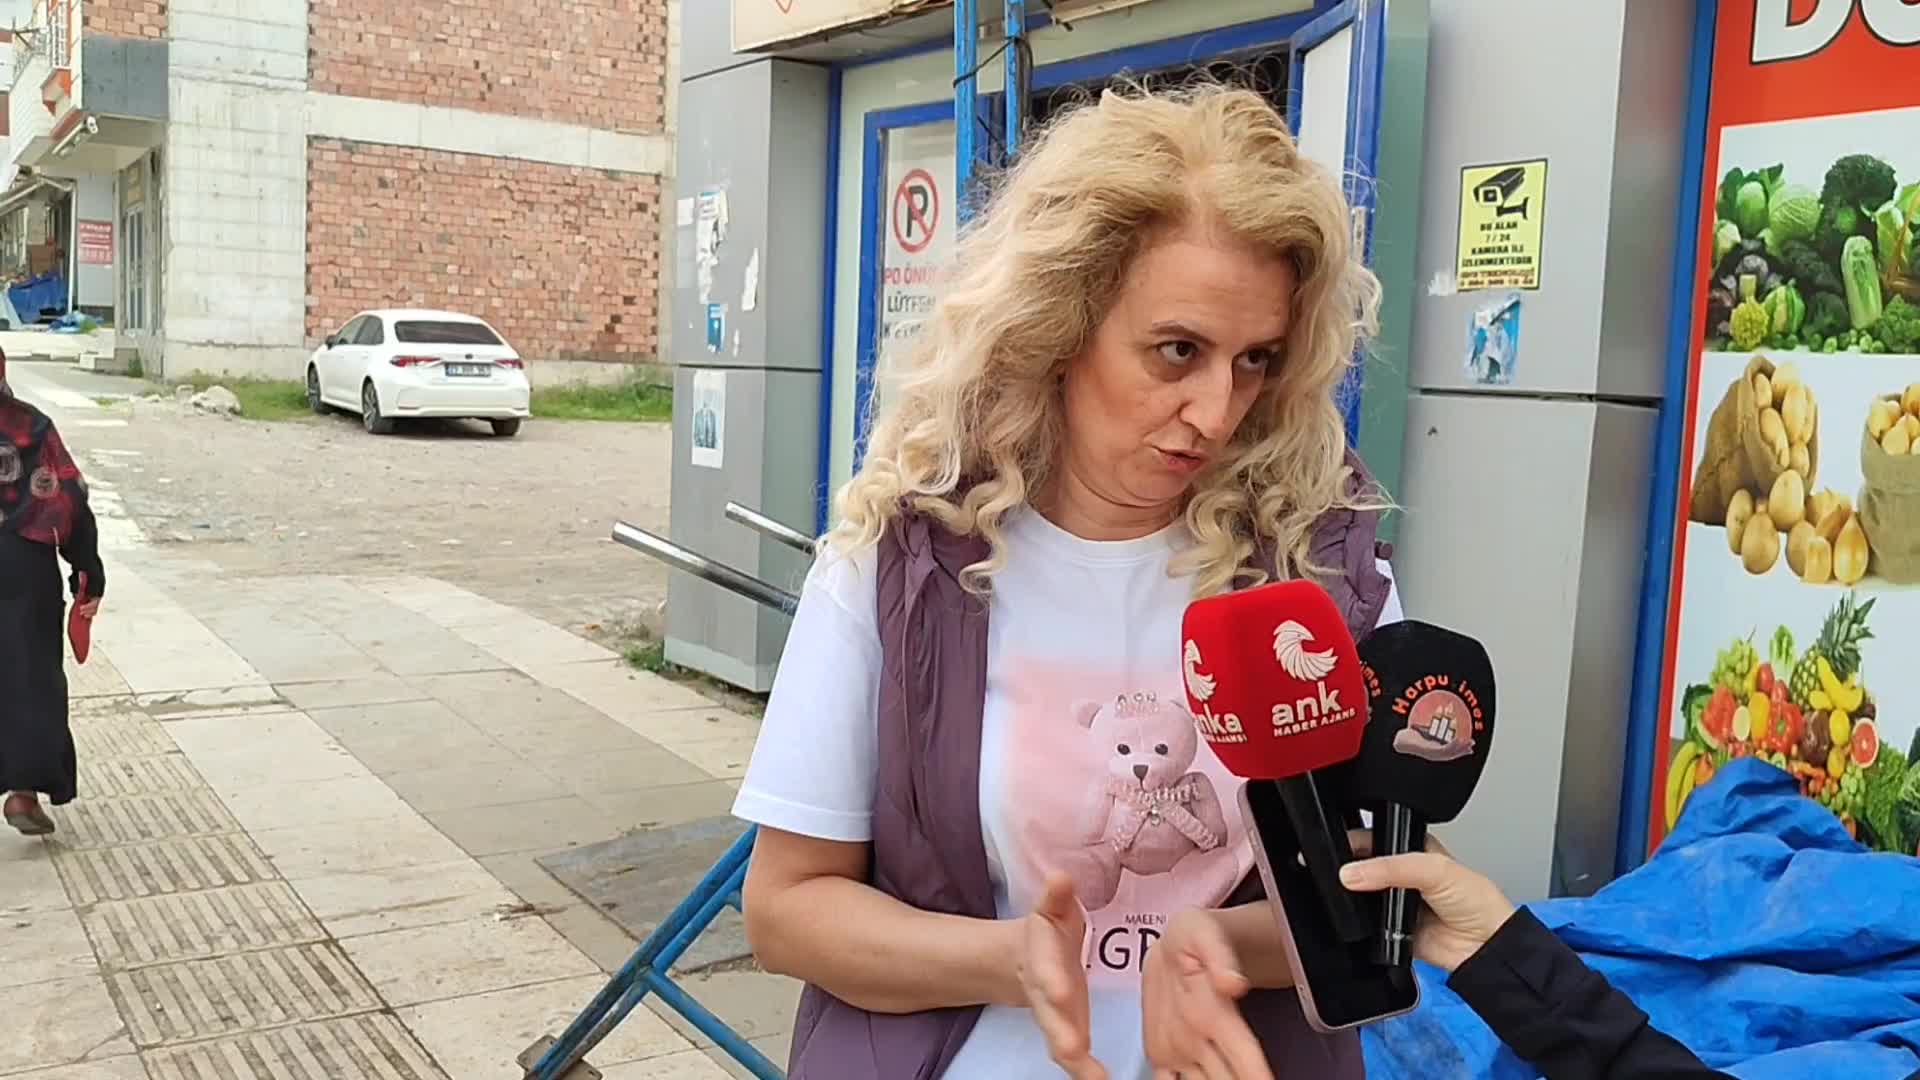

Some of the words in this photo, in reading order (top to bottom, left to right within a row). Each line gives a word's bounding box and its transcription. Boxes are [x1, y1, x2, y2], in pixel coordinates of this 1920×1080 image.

[1471, 245, 1509, 255] KAMERA
[1196, 703, 1243, 735] nka
[1273, 719, 1317, 737] HABER
